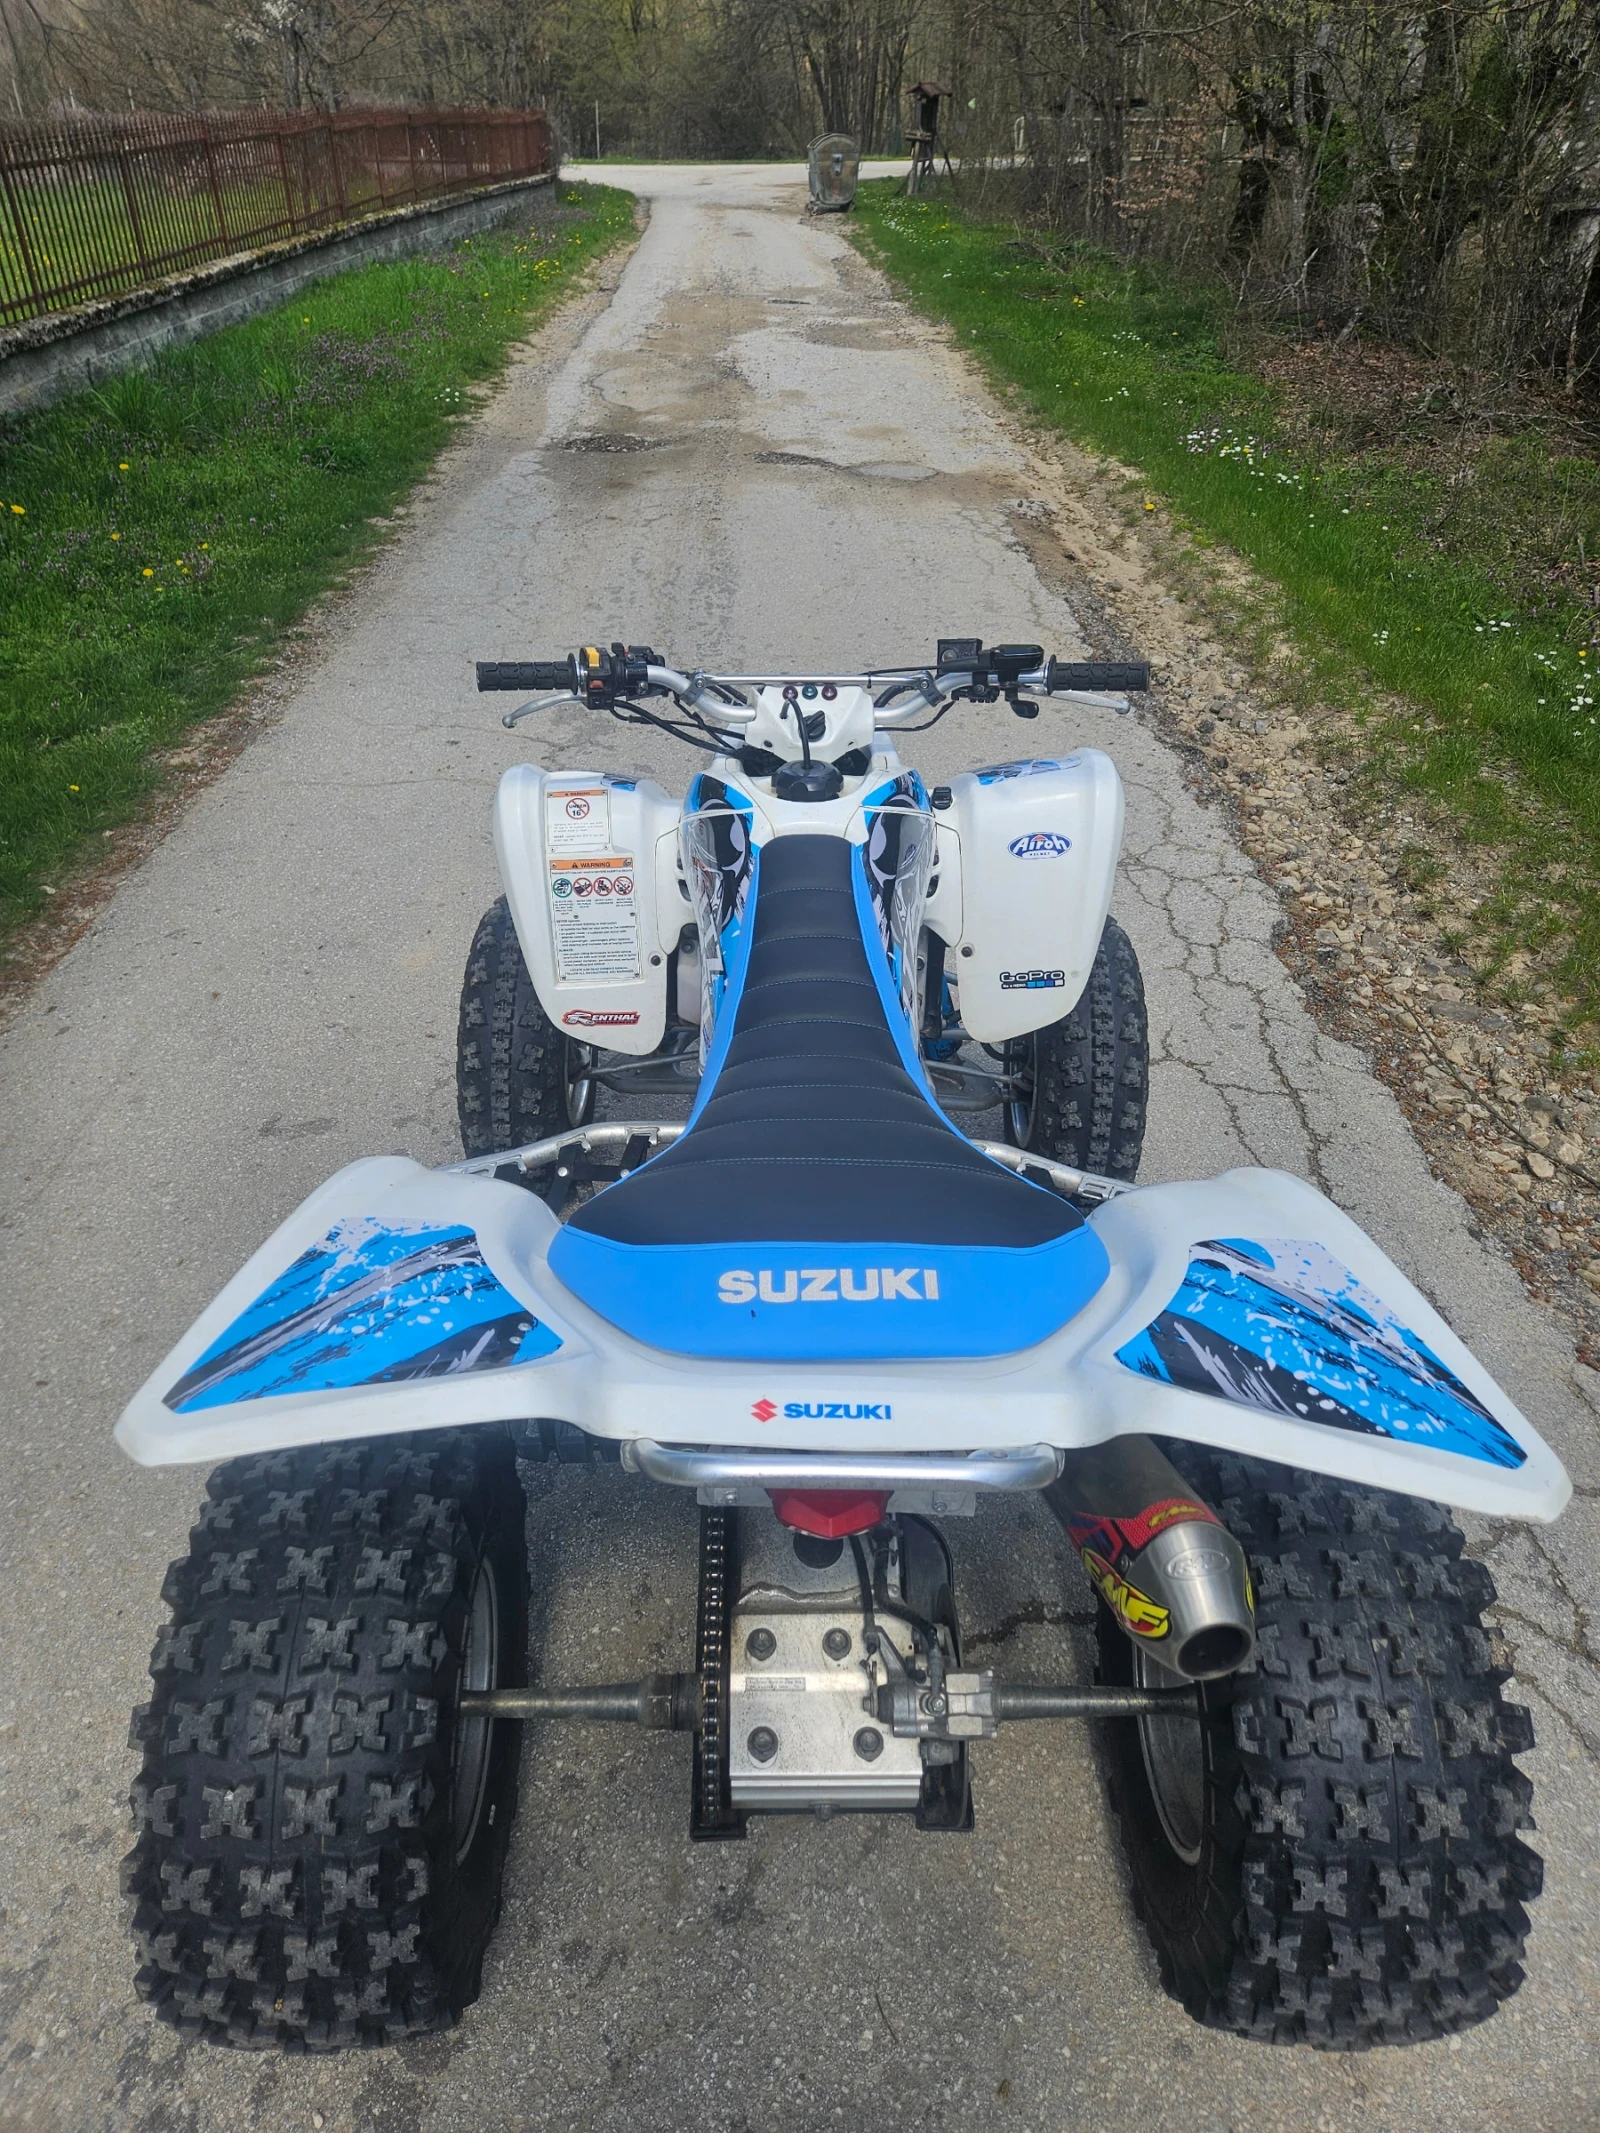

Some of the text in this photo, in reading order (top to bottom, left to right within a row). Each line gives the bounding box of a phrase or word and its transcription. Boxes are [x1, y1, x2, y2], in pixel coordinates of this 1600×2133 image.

[1012, 835, 1068, 854] Airoh
[580, 861, 611, 869] WARNING
[1001, 971, 1064, 982] GoPro
[717, 1268, 940, 1304] SUZUKI
[783, 1403, 892, 1420] SUZUKI
